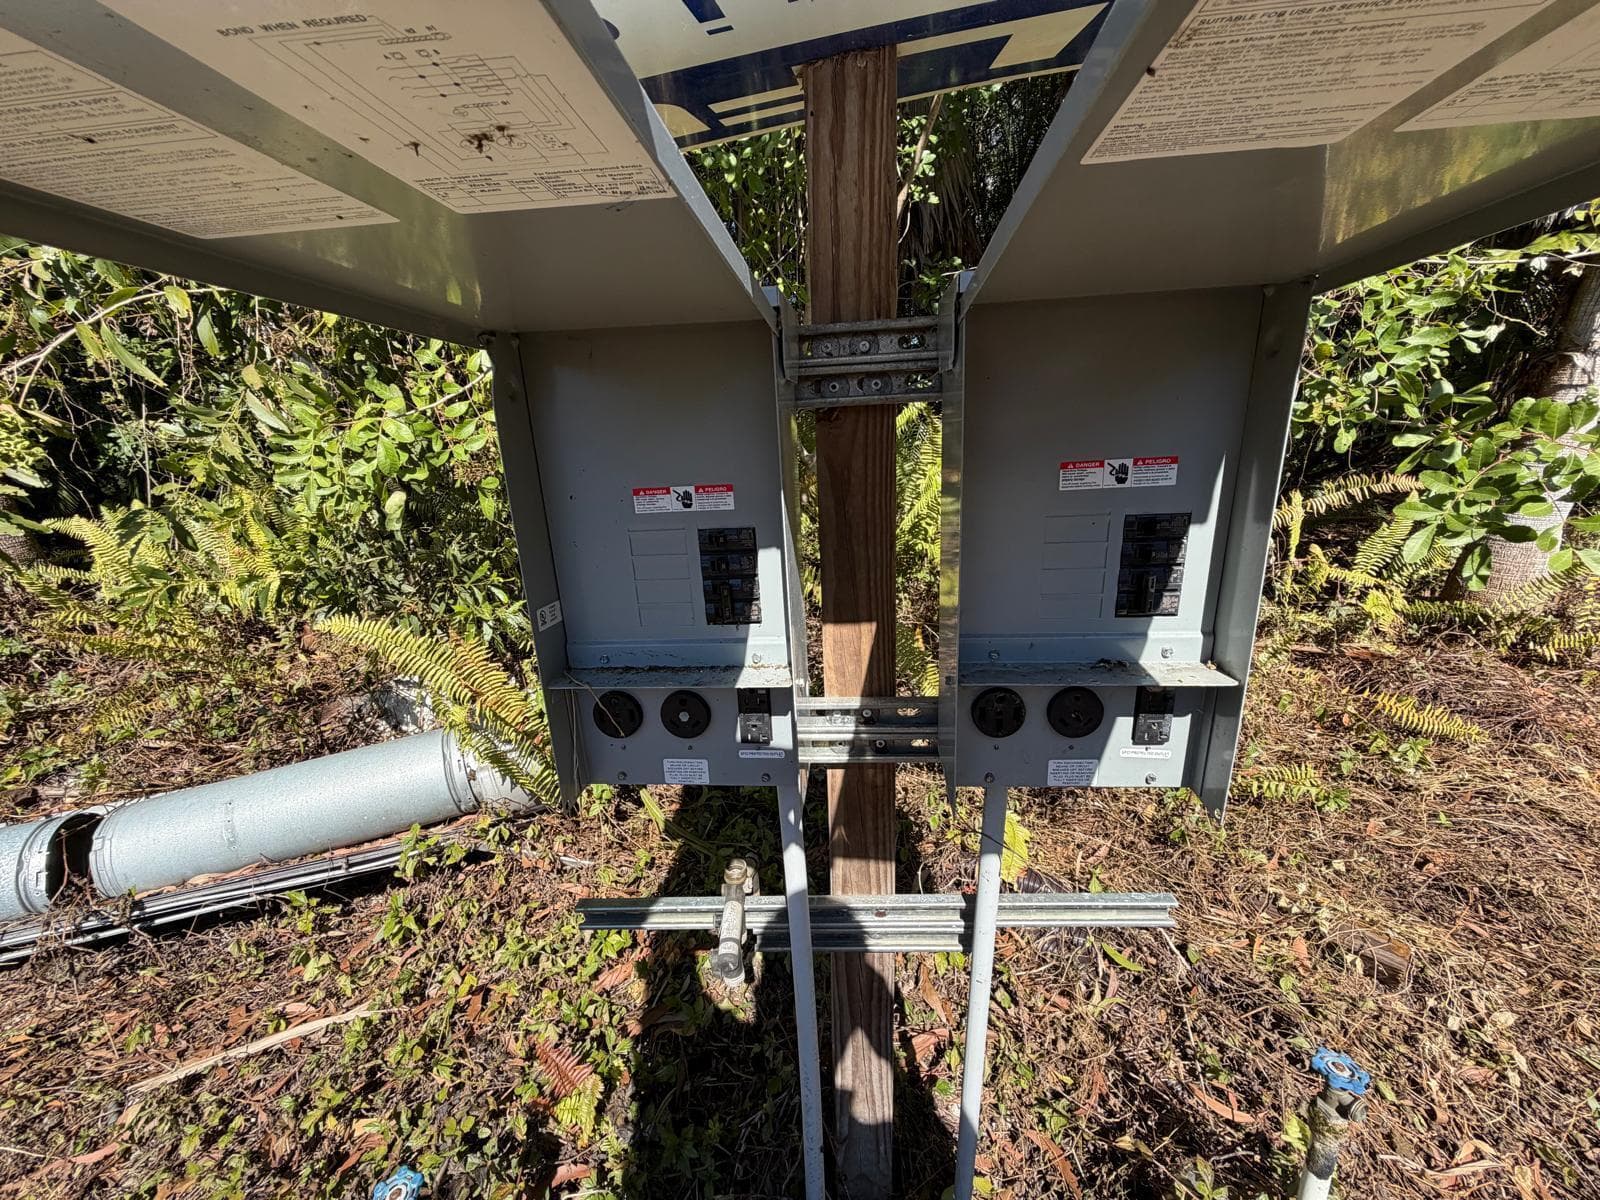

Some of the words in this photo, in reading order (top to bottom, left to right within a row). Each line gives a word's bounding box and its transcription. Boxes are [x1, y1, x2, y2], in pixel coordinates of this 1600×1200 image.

[216, 26, 255, 37] BOND
[258, 21, 300, 32] WHEN
[302, 14, 368, 29] REQUIRED
[1198, 14, 1258, 26] SUITABLE
